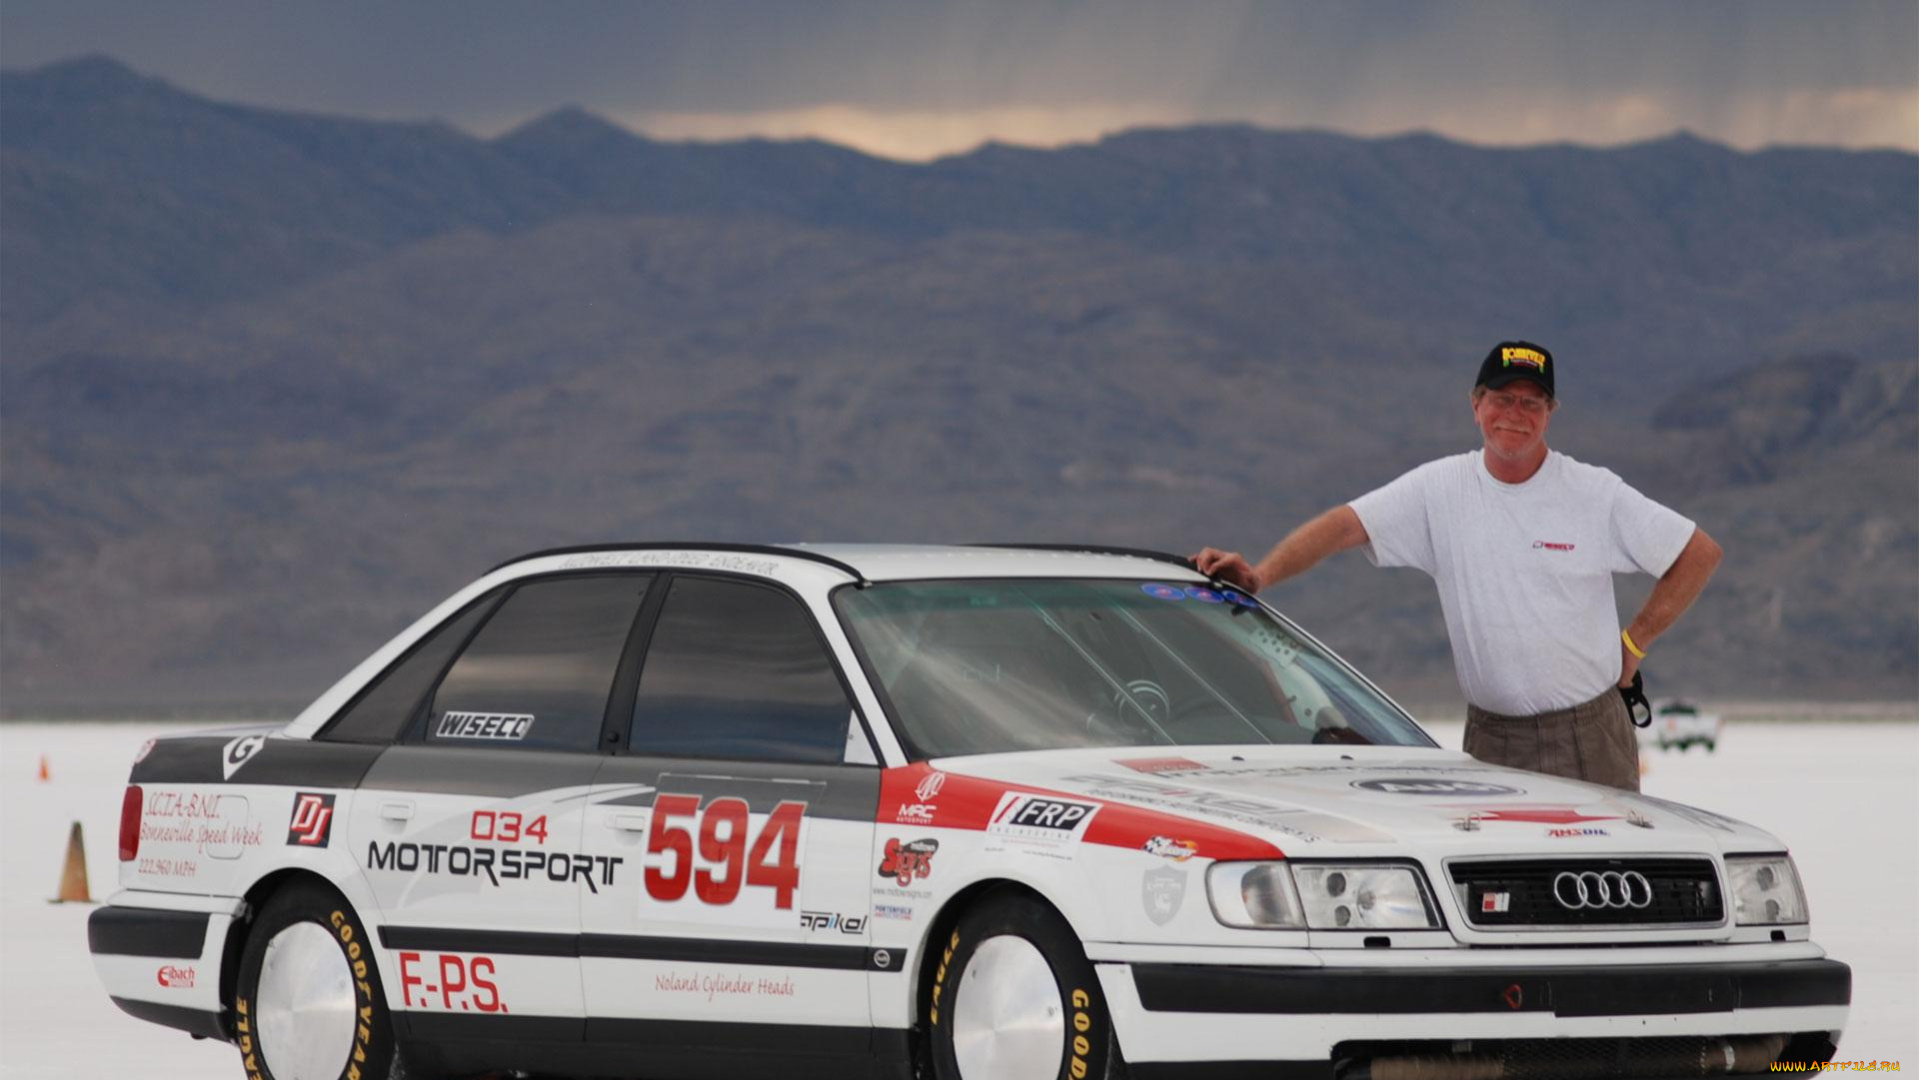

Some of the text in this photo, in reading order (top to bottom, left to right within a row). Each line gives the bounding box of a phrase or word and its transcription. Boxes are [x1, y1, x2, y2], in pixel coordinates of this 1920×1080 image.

[471, 810, 548, 845] 034
[1017, 801, 1086, 828] FRP
[367, 840, 624, 895] MOTORSPORT
[643, 792, 809, 912] 594
[655, 971, 795, 1003] Noland Cylinder Heads
